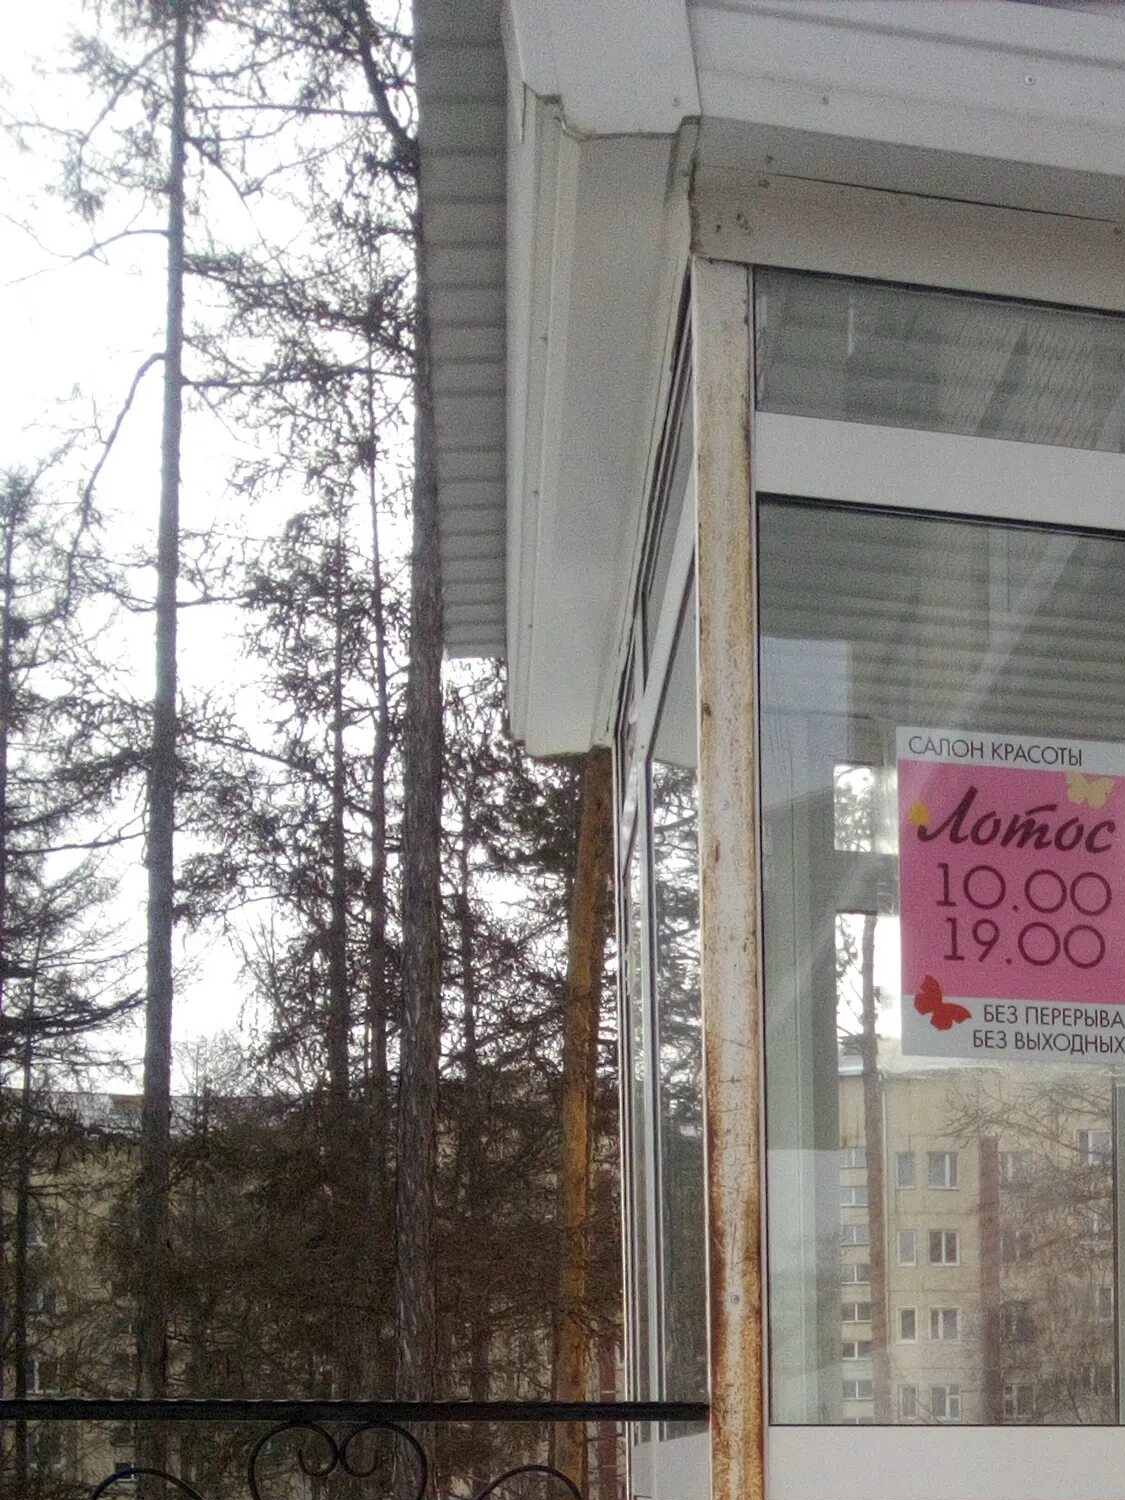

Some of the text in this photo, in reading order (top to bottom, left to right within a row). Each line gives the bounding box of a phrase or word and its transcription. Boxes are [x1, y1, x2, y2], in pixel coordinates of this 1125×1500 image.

[908, 736, 1082, 767] САЛОН КРАСОТЫ
[917, 786, 1116, 854] Лотос
[936, 862, 1112, 917] 10.00
[943, 917, 1106, 969] 19.00
[984, 1004, 1125, 1030] БЕЗ ПЕРЕРЫВА
[973, 1029, 1125, 1056] БЕЗ ВЫХОДНЫХ
